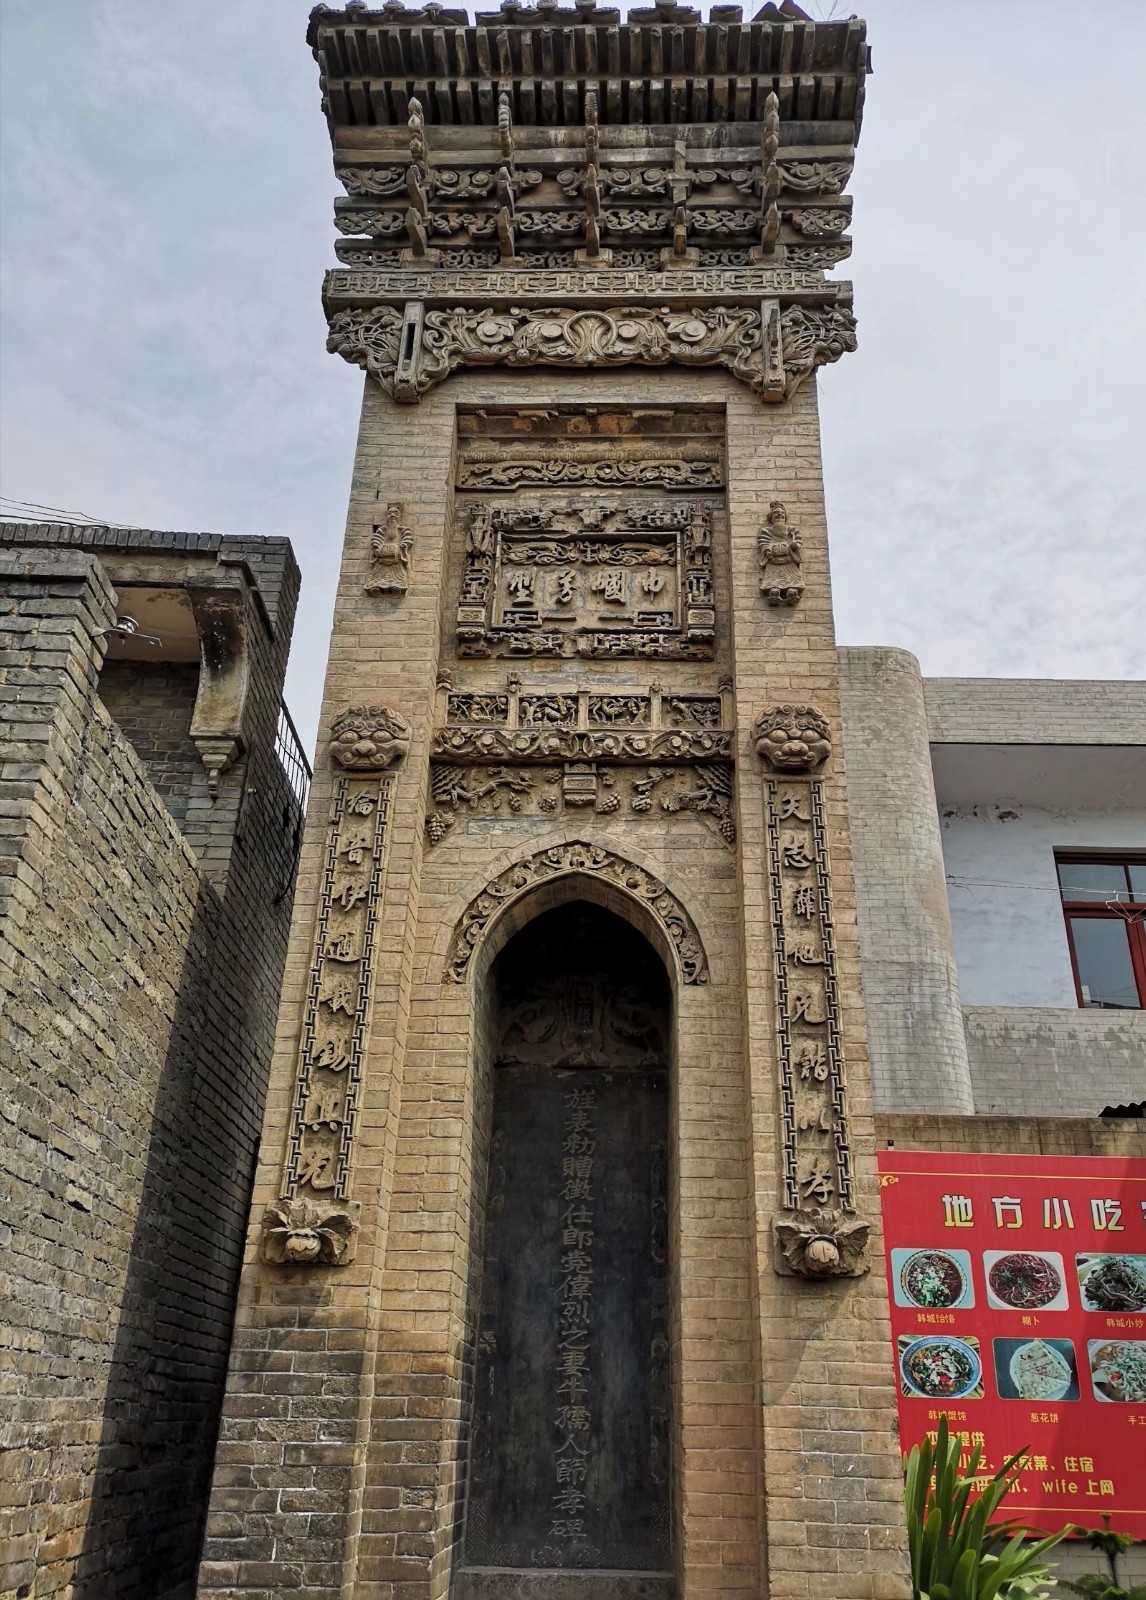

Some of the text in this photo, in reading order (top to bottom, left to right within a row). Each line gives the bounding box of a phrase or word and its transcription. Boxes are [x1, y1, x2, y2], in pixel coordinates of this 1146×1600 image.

[941, 1194, 1146, 1232] 地方小吃
[1030, 1412, 1059, 1423] 葱花饼
[1042, 1479, 1078, 1494] wife
[1086, 1479, 1115, 1496] 上网
